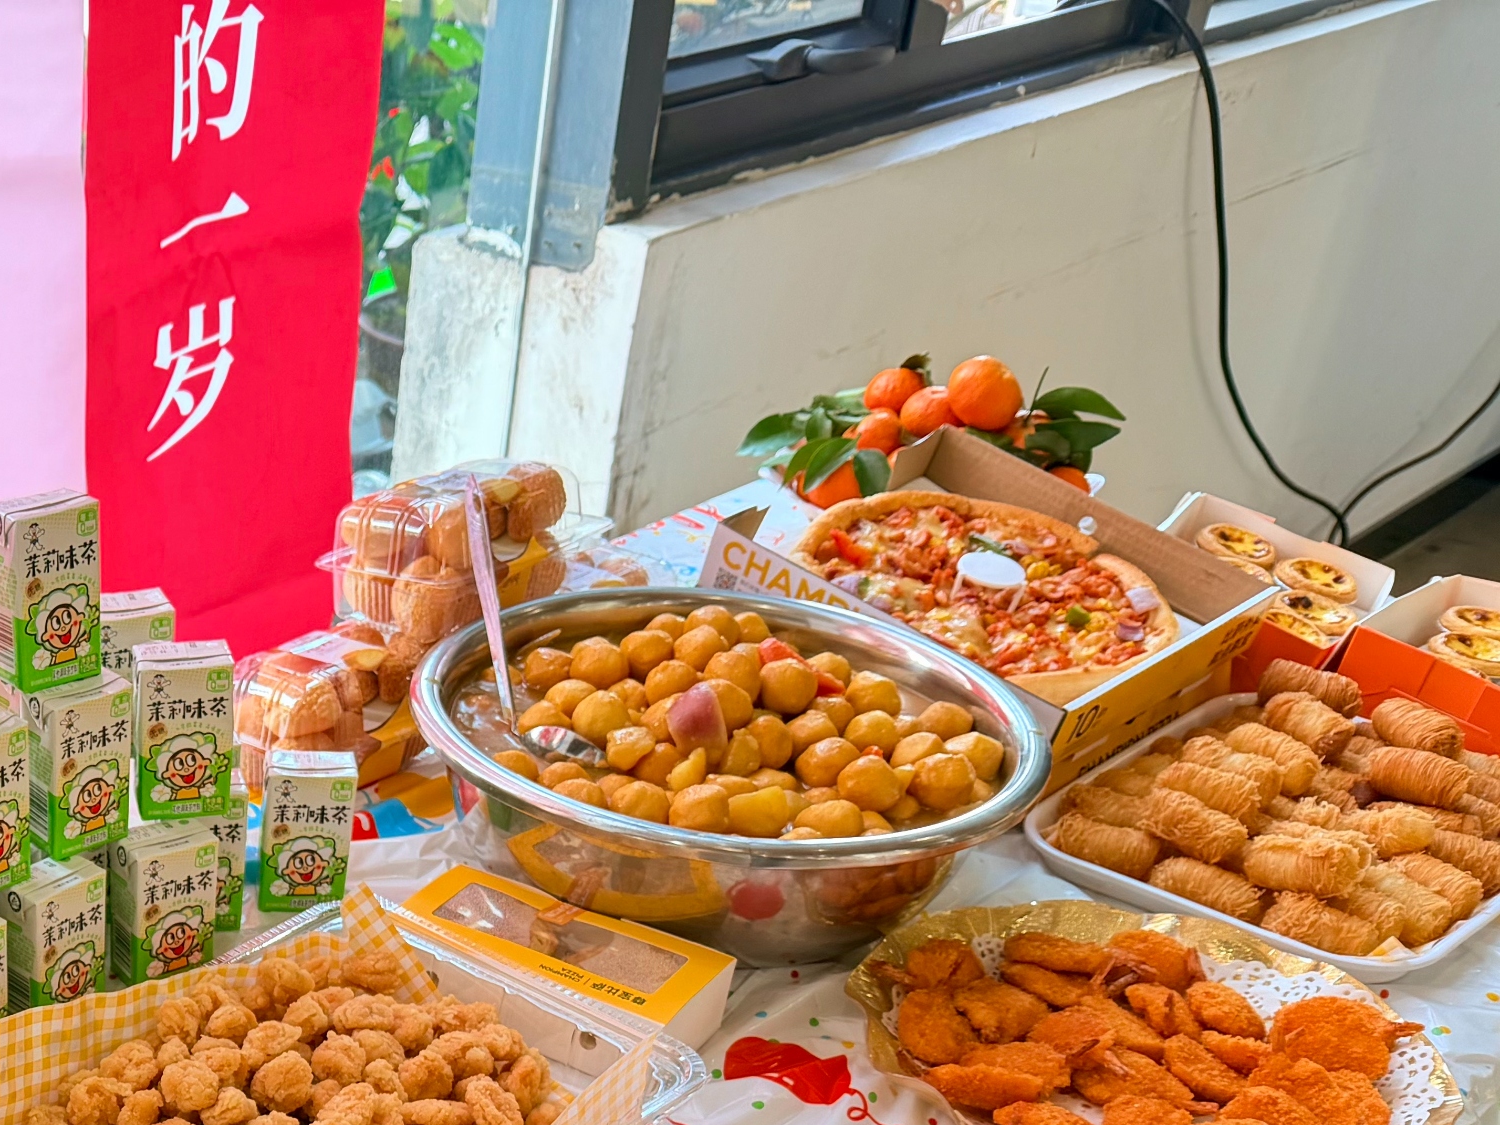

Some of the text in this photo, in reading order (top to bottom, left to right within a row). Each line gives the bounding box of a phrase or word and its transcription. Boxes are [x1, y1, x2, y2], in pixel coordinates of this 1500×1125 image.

[147, 2, 264, 463] 的一岁
[24, 539, 98, 579] 茉莉味茶
[147, 698, 229, 722] 茉莉味茶
[61, 720, 129, 759] 茉莉味茶
[273, 805, 351, 825] 茉莉味茶
[145, 870, 214, 905] 茉莉味茶
[43, 903, 103, 947] 茉莉味茶
[539, 964, 580, 983] CHAMPION
[561, 967, 584, 979] PIZZA
